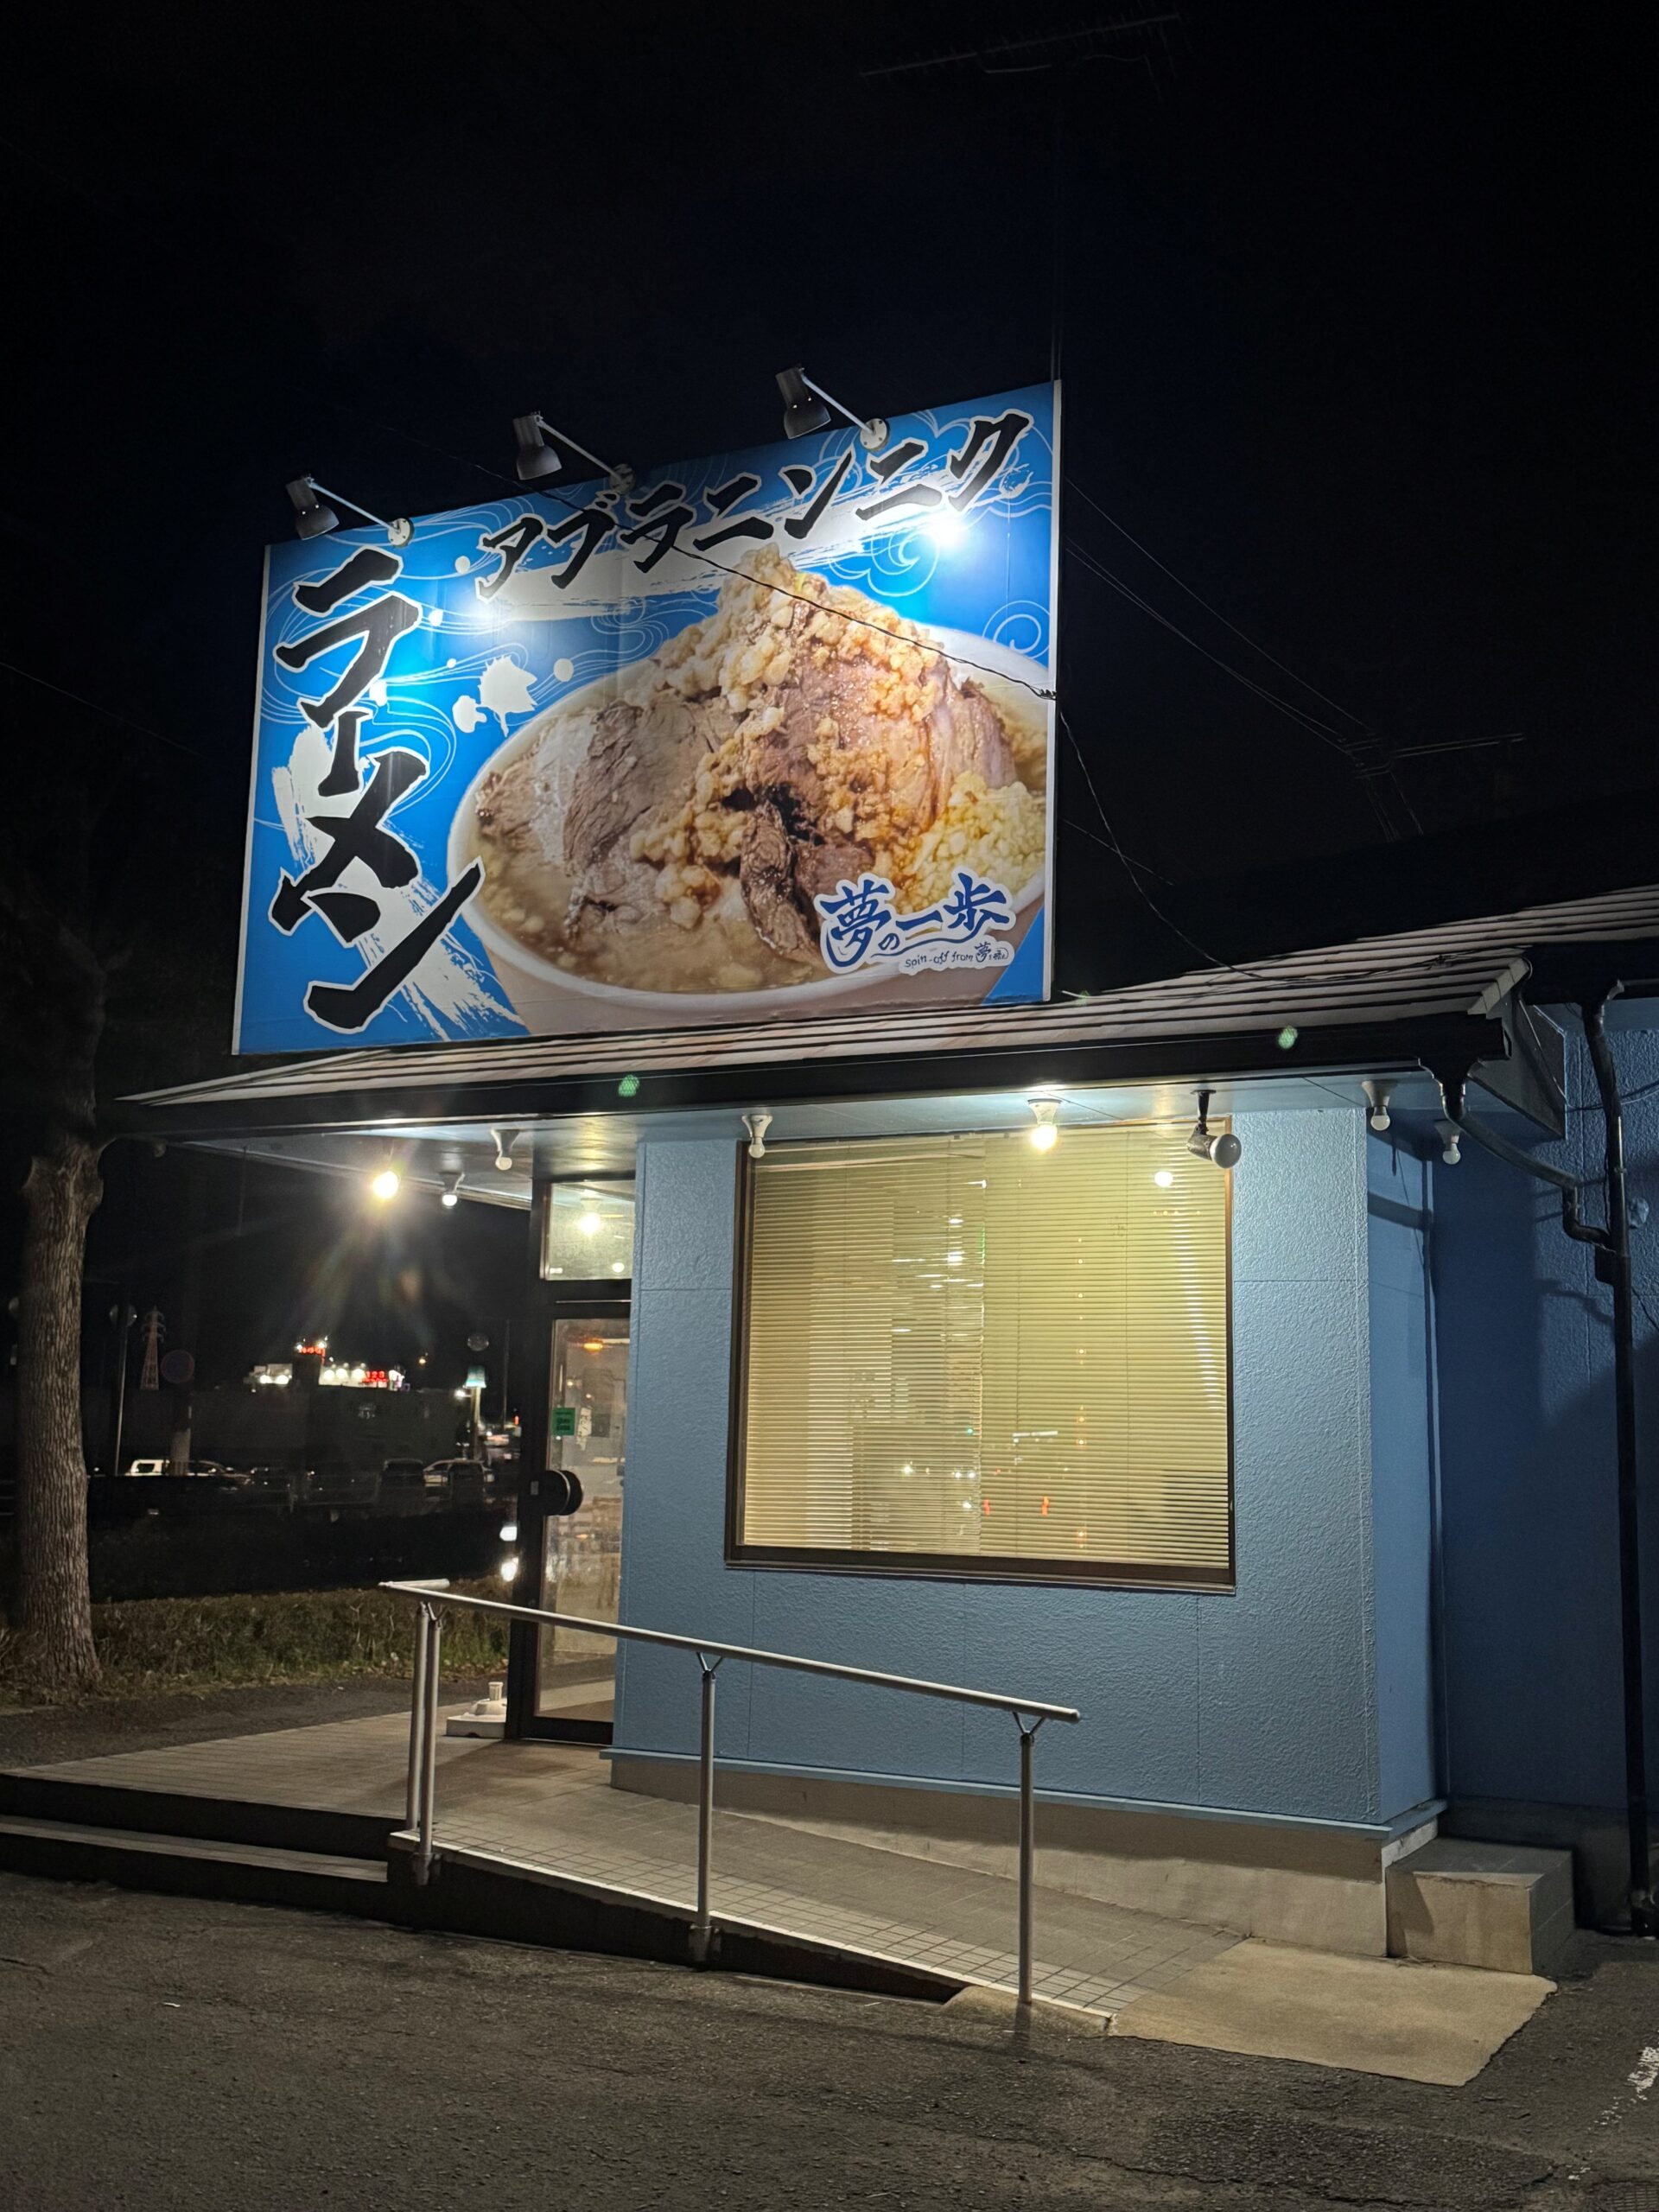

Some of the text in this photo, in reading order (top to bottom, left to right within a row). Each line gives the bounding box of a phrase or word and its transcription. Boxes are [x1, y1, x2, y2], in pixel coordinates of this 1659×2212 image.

[476, 411, 1031, 599] アブラニンニク
[270, 548, 481, 1030] ラーメン
[819, 872, 1010, 967] 夢の一歩
[951, 951, 974, 963] from
